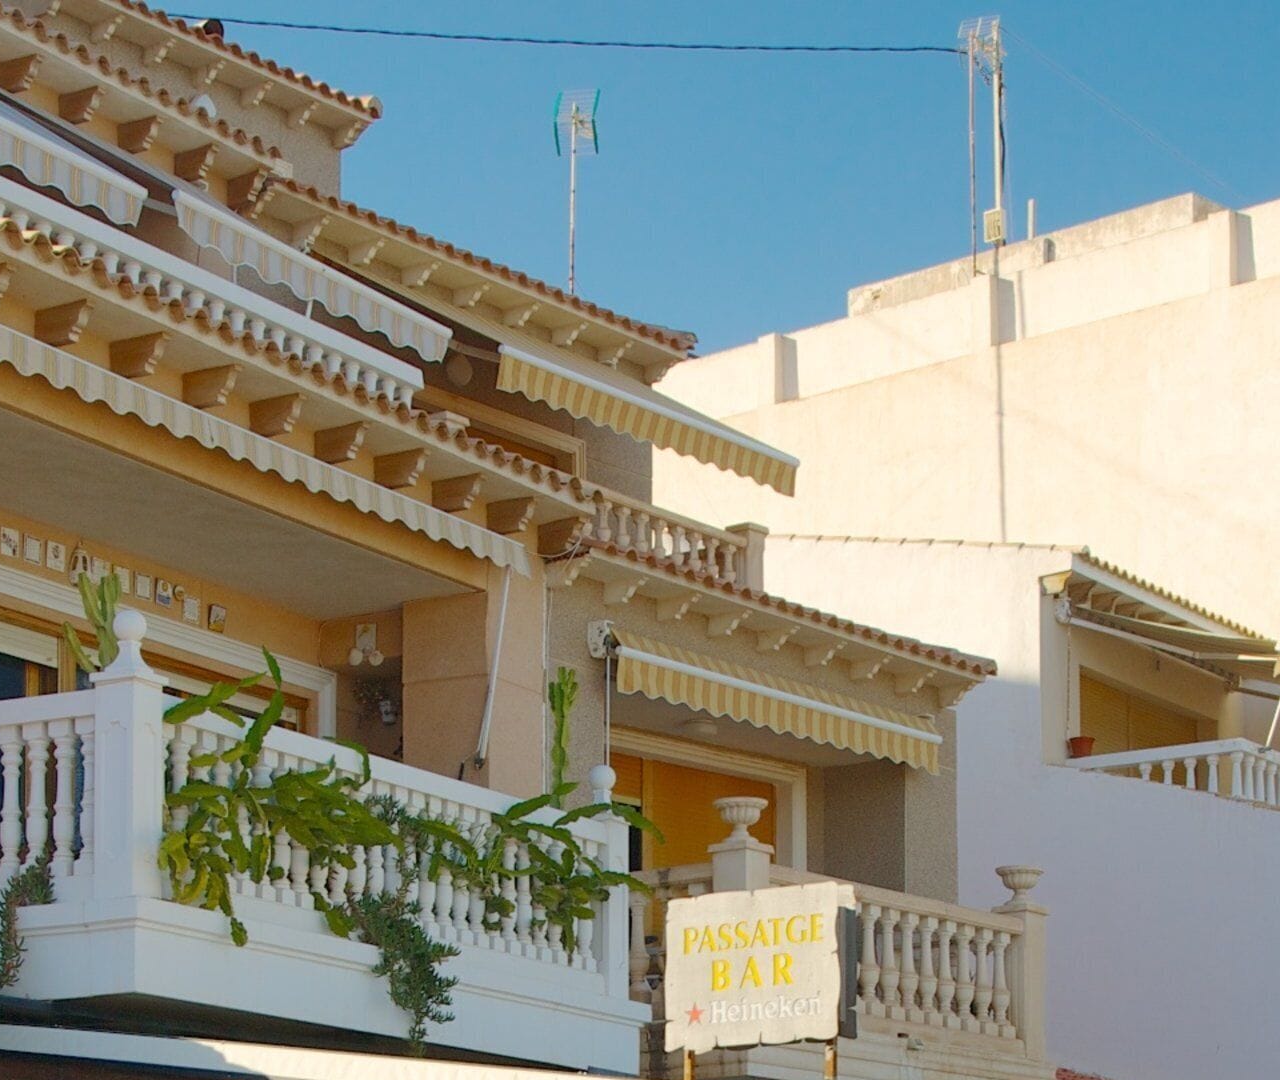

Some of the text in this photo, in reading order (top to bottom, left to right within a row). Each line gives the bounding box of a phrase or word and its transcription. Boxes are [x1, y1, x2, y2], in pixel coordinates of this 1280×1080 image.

[683, 913, 824, 955] PASSATGE
[710, 952, 795, 992] BAR
[709, 992, 822, 1025] Heineken
